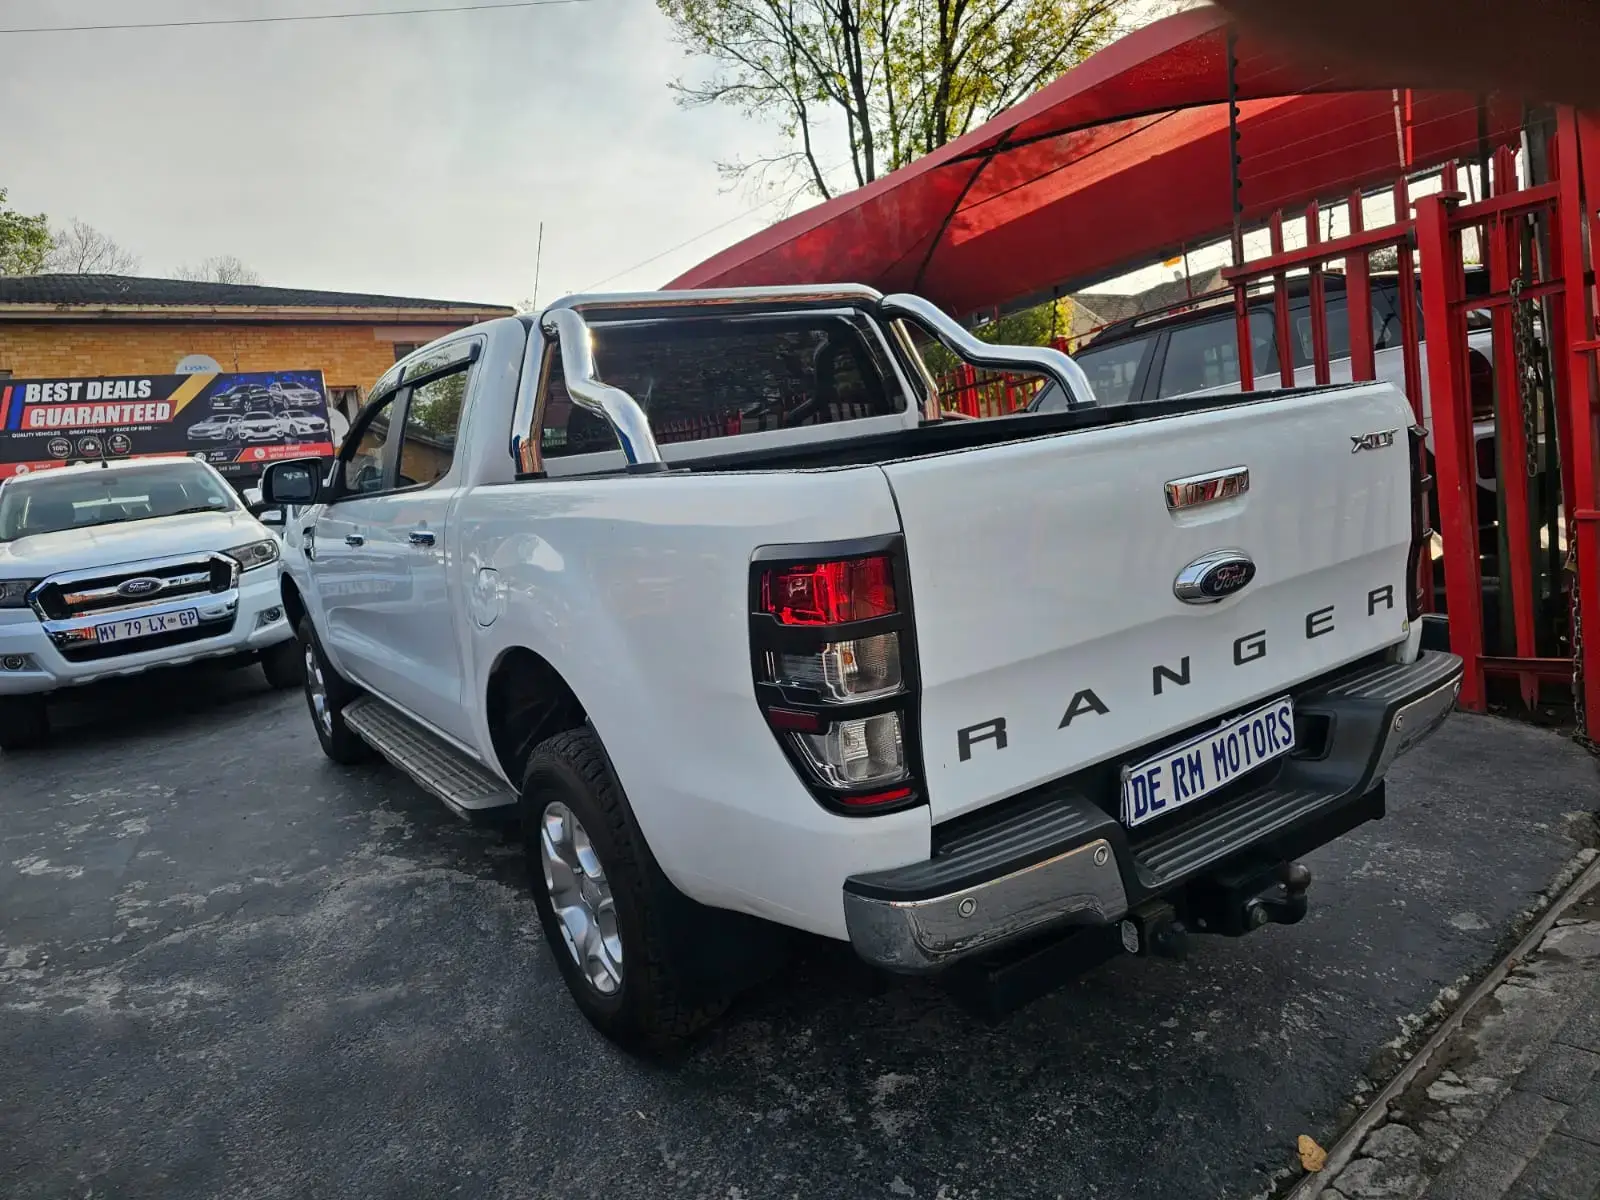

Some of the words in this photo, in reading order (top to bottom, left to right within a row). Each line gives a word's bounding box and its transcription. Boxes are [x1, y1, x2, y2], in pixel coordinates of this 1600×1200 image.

[25, 381, 83, 403] BEST
[86, 379, 152, 400] DEALS
[29, 402, 171, 428] GUARANTEED
[128, 581, 152, 593] Ford
[1213, 563, 1248, 591] Ford
[100, 624, 116, 642] MY
[124, 620, 142, 636] 79
[149, 615, 167, 632] LX
[179, 610, 195, 626] GP
[957, 584, 1394, 762] RANGER
[1131, 766, 1166, 819] DE
[1170, 749, 1205, 802] RM
[1211, 705, 1293, 782] MOTORS
